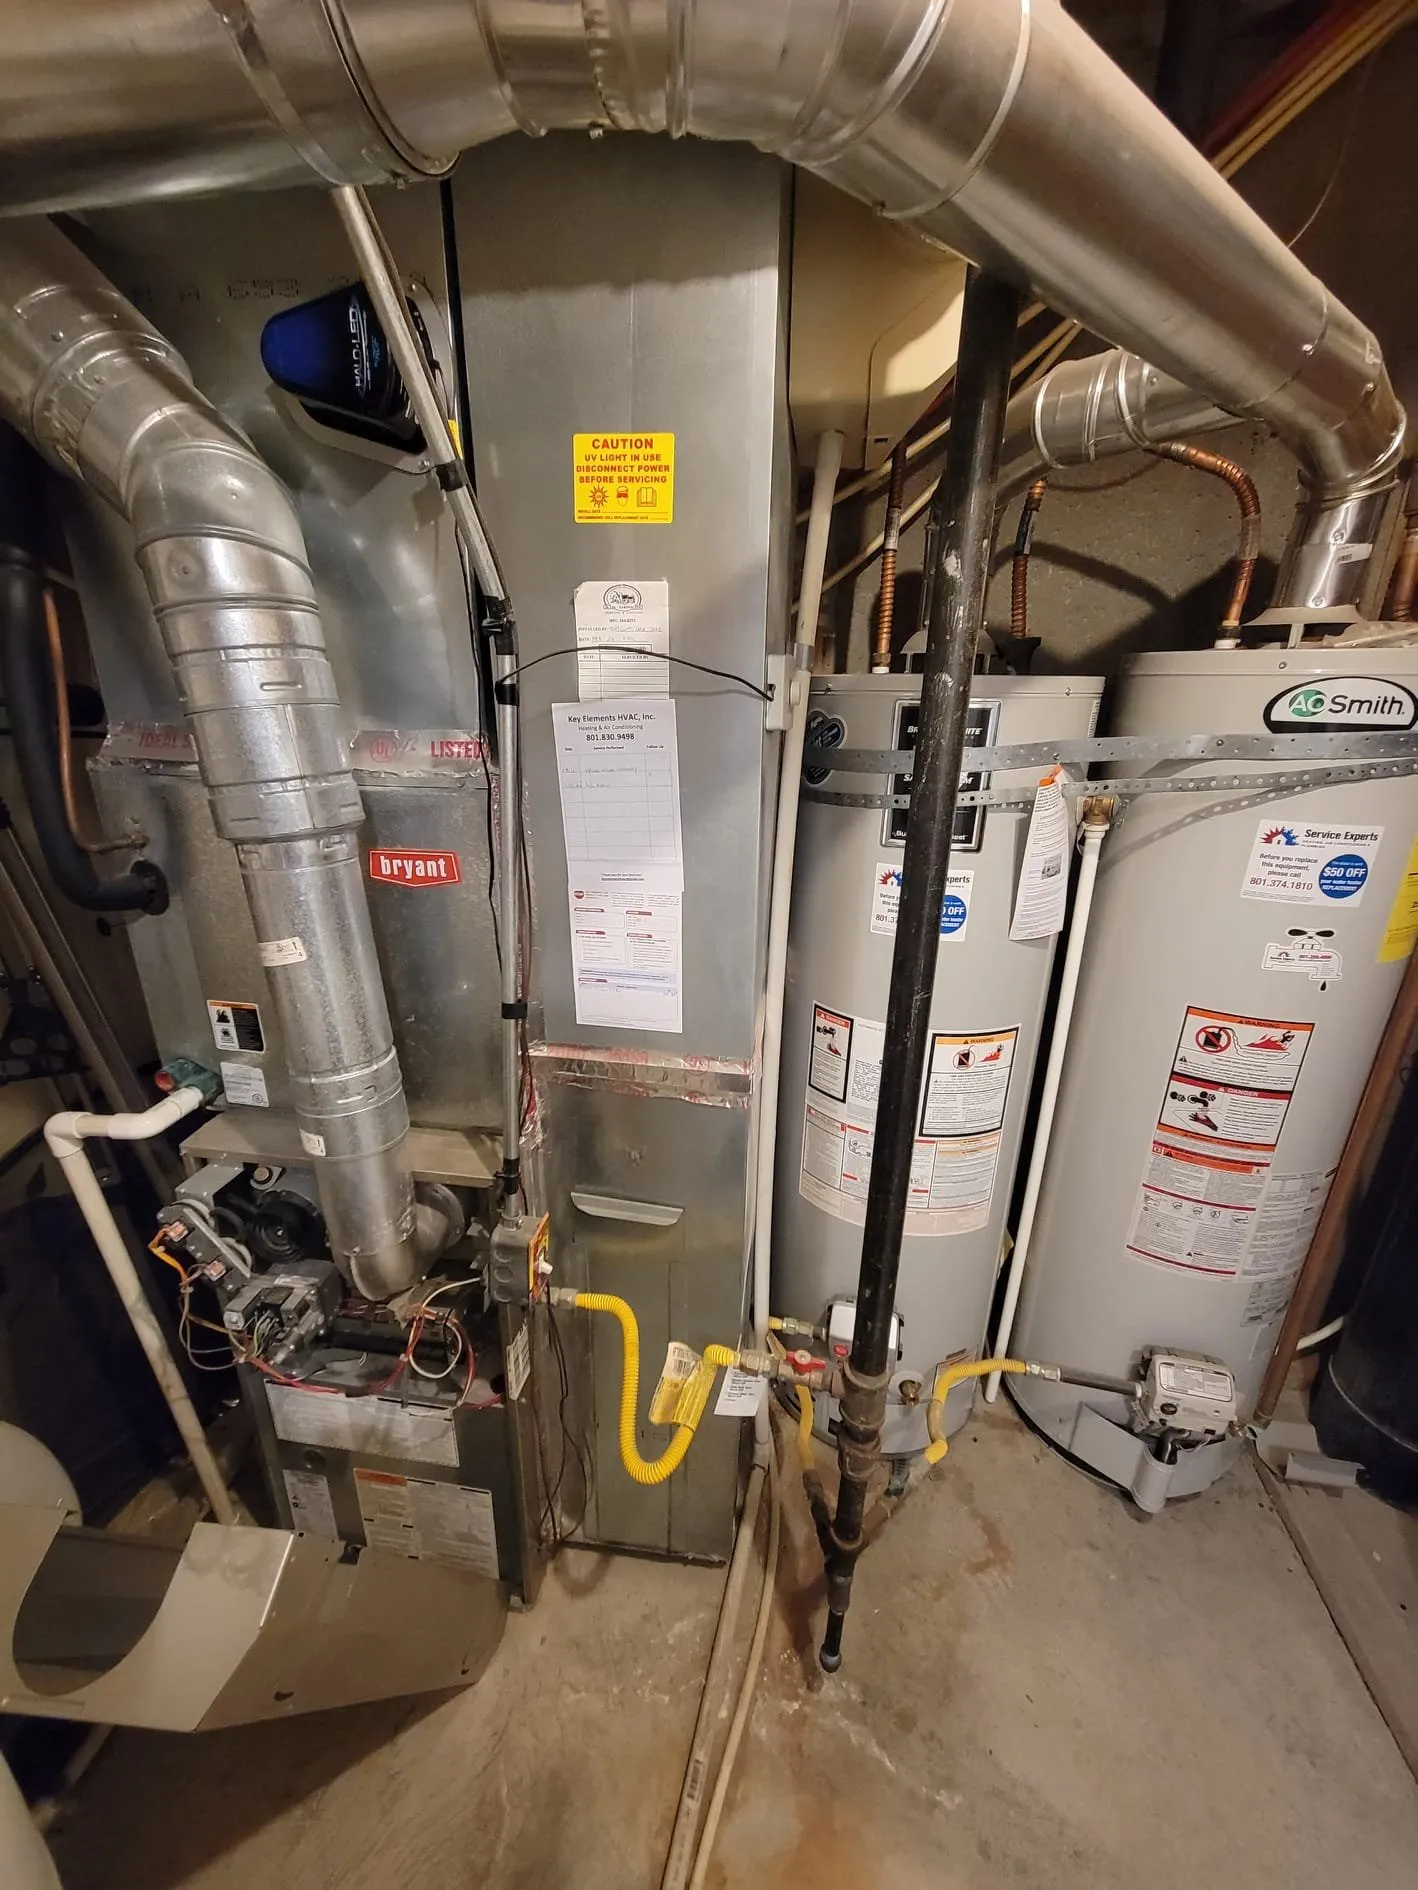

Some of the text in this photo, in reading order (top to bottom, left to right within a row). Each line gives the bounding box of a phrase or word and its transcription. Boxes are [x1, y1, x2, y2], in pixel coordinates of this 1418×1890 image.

[592, 438, 654, 450] CAUTION
[584, 453, 662, 462] UV LIGHT IN USE
[576, 464, 671, 473] DISCONNECT POWER
[579, 475, 667, 484] BEFORE SERVICING
[567, 715, 581, 724] Key
[582, 714, 616, 723] Elements
[617, 713, 641, 721] HVAC,
[586, 733, 635, 741] 801.830.9498
[430, 740, 483, 760] LISTED
[1304, 828, 1379, 842] Service Experts
[1259, 853, 1280, 861] Before
[1294, 856, 1319, 864] replace
[380, 855, 447, 880] bryant
[1274, 863, 1311, 872] equipment,
[1322, 867, 1367, 878] $50 OFF
[945, 875, 970, 884] xperts
[1249, 877, 1313, 891] 801.374.1810
[947, 906, 965, 916] OFF
[1227, 1087, 1260, 1097] DANGER
